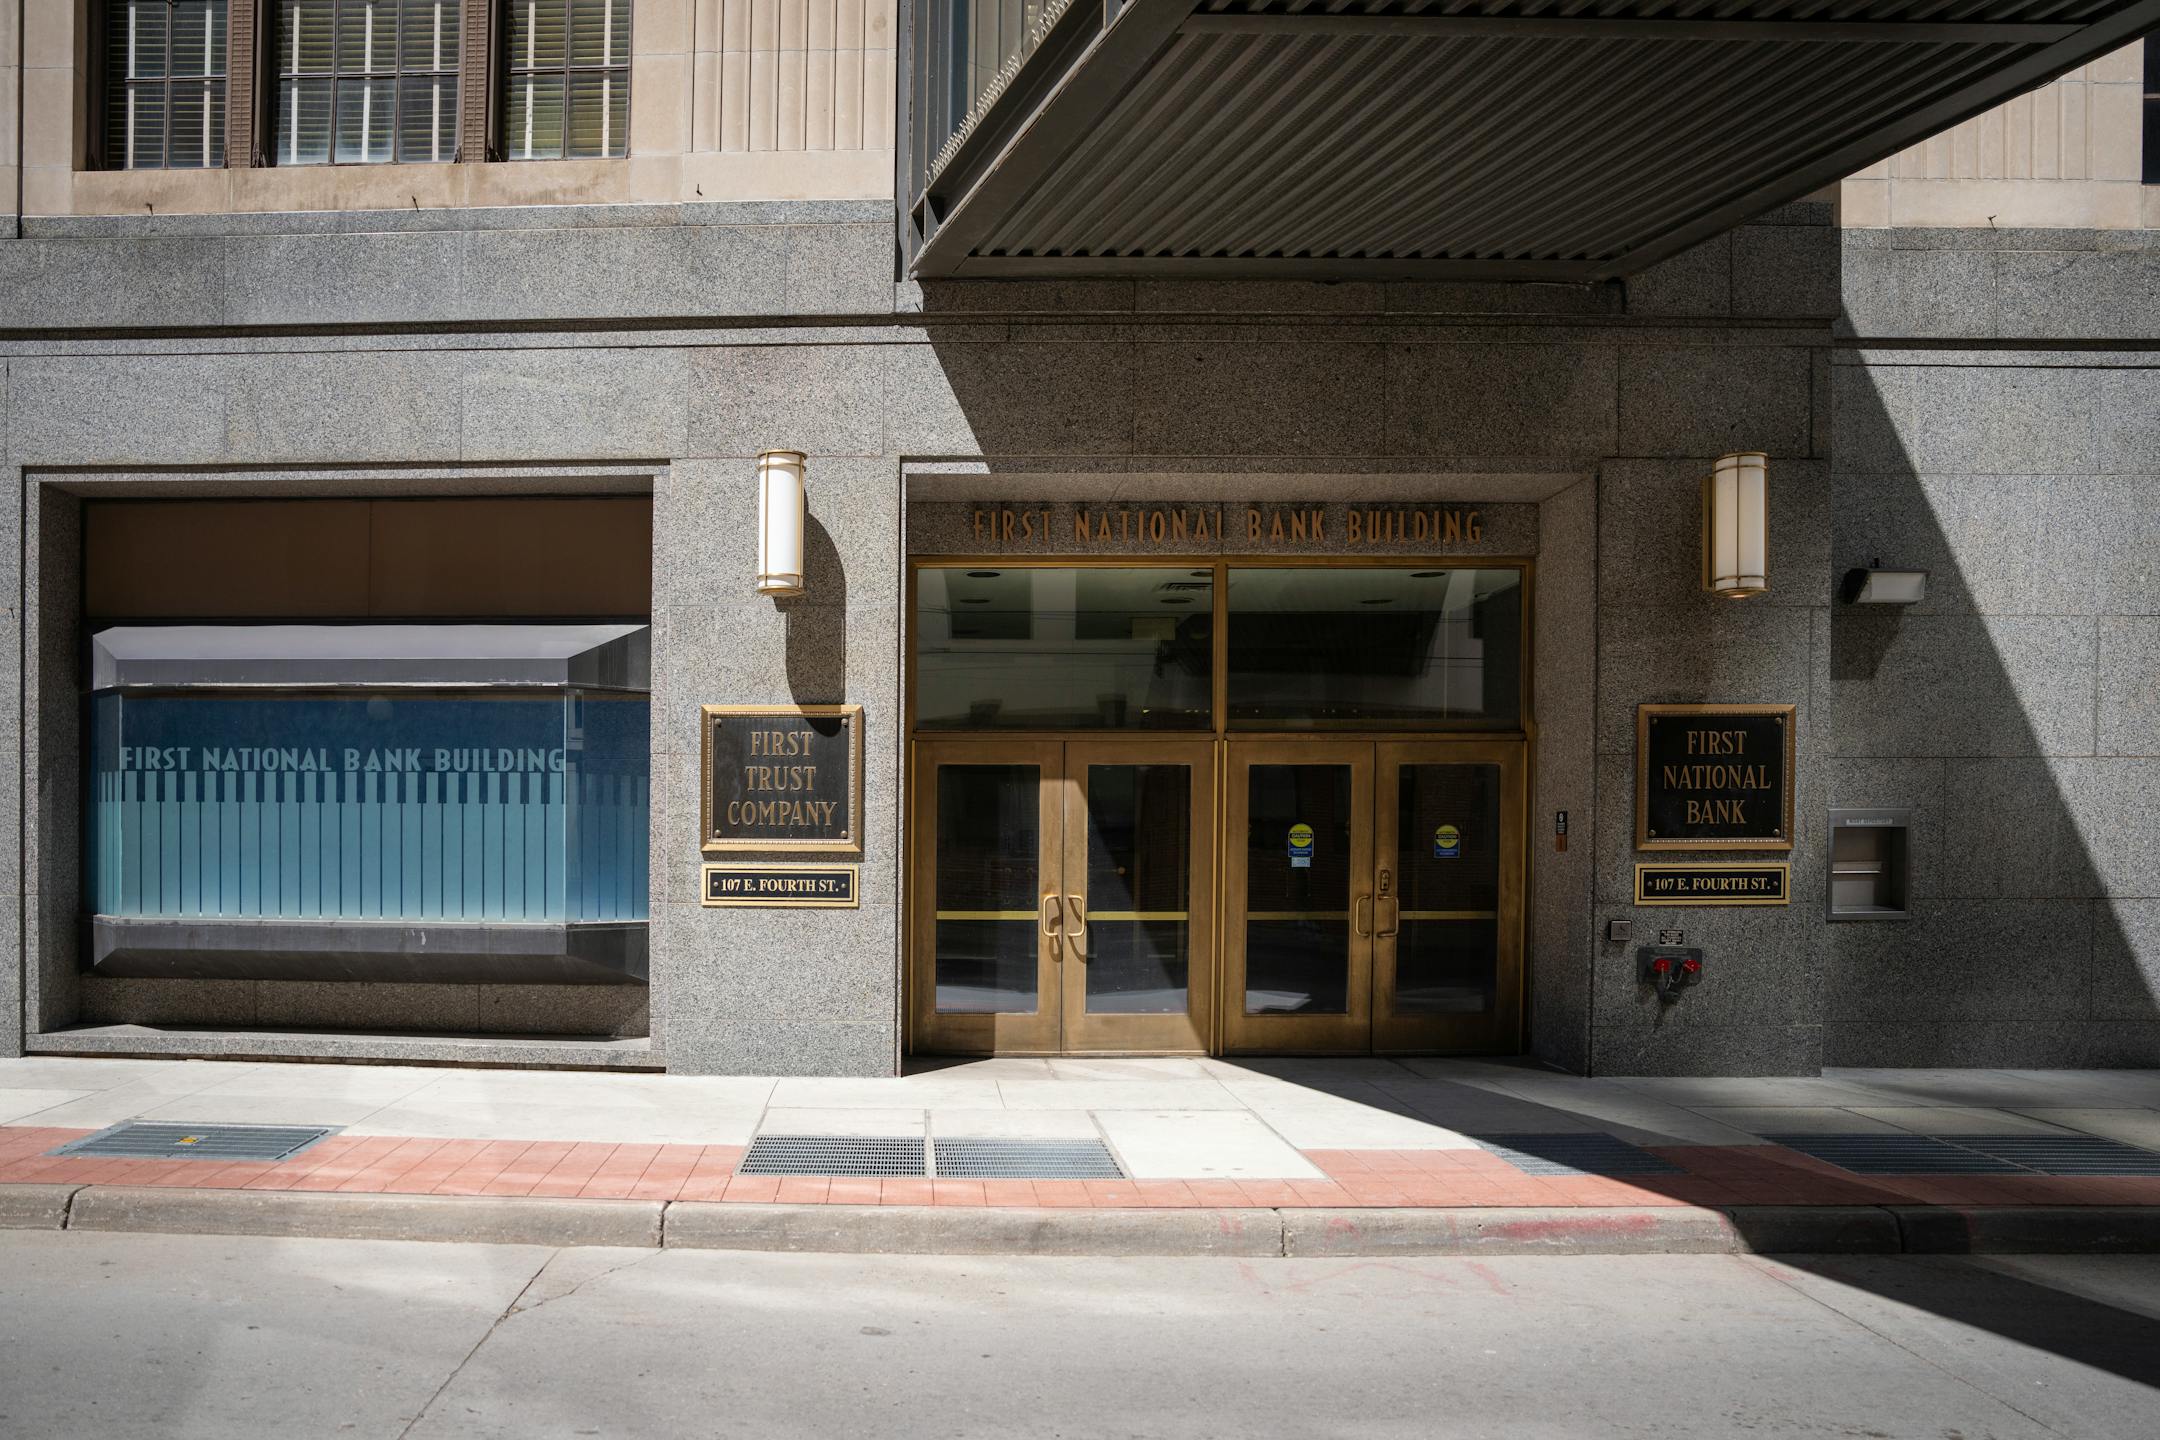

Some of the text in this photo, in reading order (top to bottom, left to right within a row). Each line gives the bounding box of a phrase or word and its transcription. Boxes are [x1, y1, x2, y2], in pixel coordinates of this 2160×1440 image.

[974, 509, 1481, 544] FIRST NATIONAL BANK BUILDING
[750, 731, 814, 757] FIRST
[1687, 730, 1747, 755] FIRST
[121, 746, 564, 772] FIRST NATIONAL BANK BUILDING
[744, 765, 817, 792] TRUST
[1663, 765, 1772, 790] NATIONAL
[727, 801, 838, 826] COMPANY
[1686, 799, 1747, 824] BANK
[720, 878, 839, 892] 107 E. FOURTH ST.
[1655, 878, 1771, 891] 107 E. FOURTH ST.
